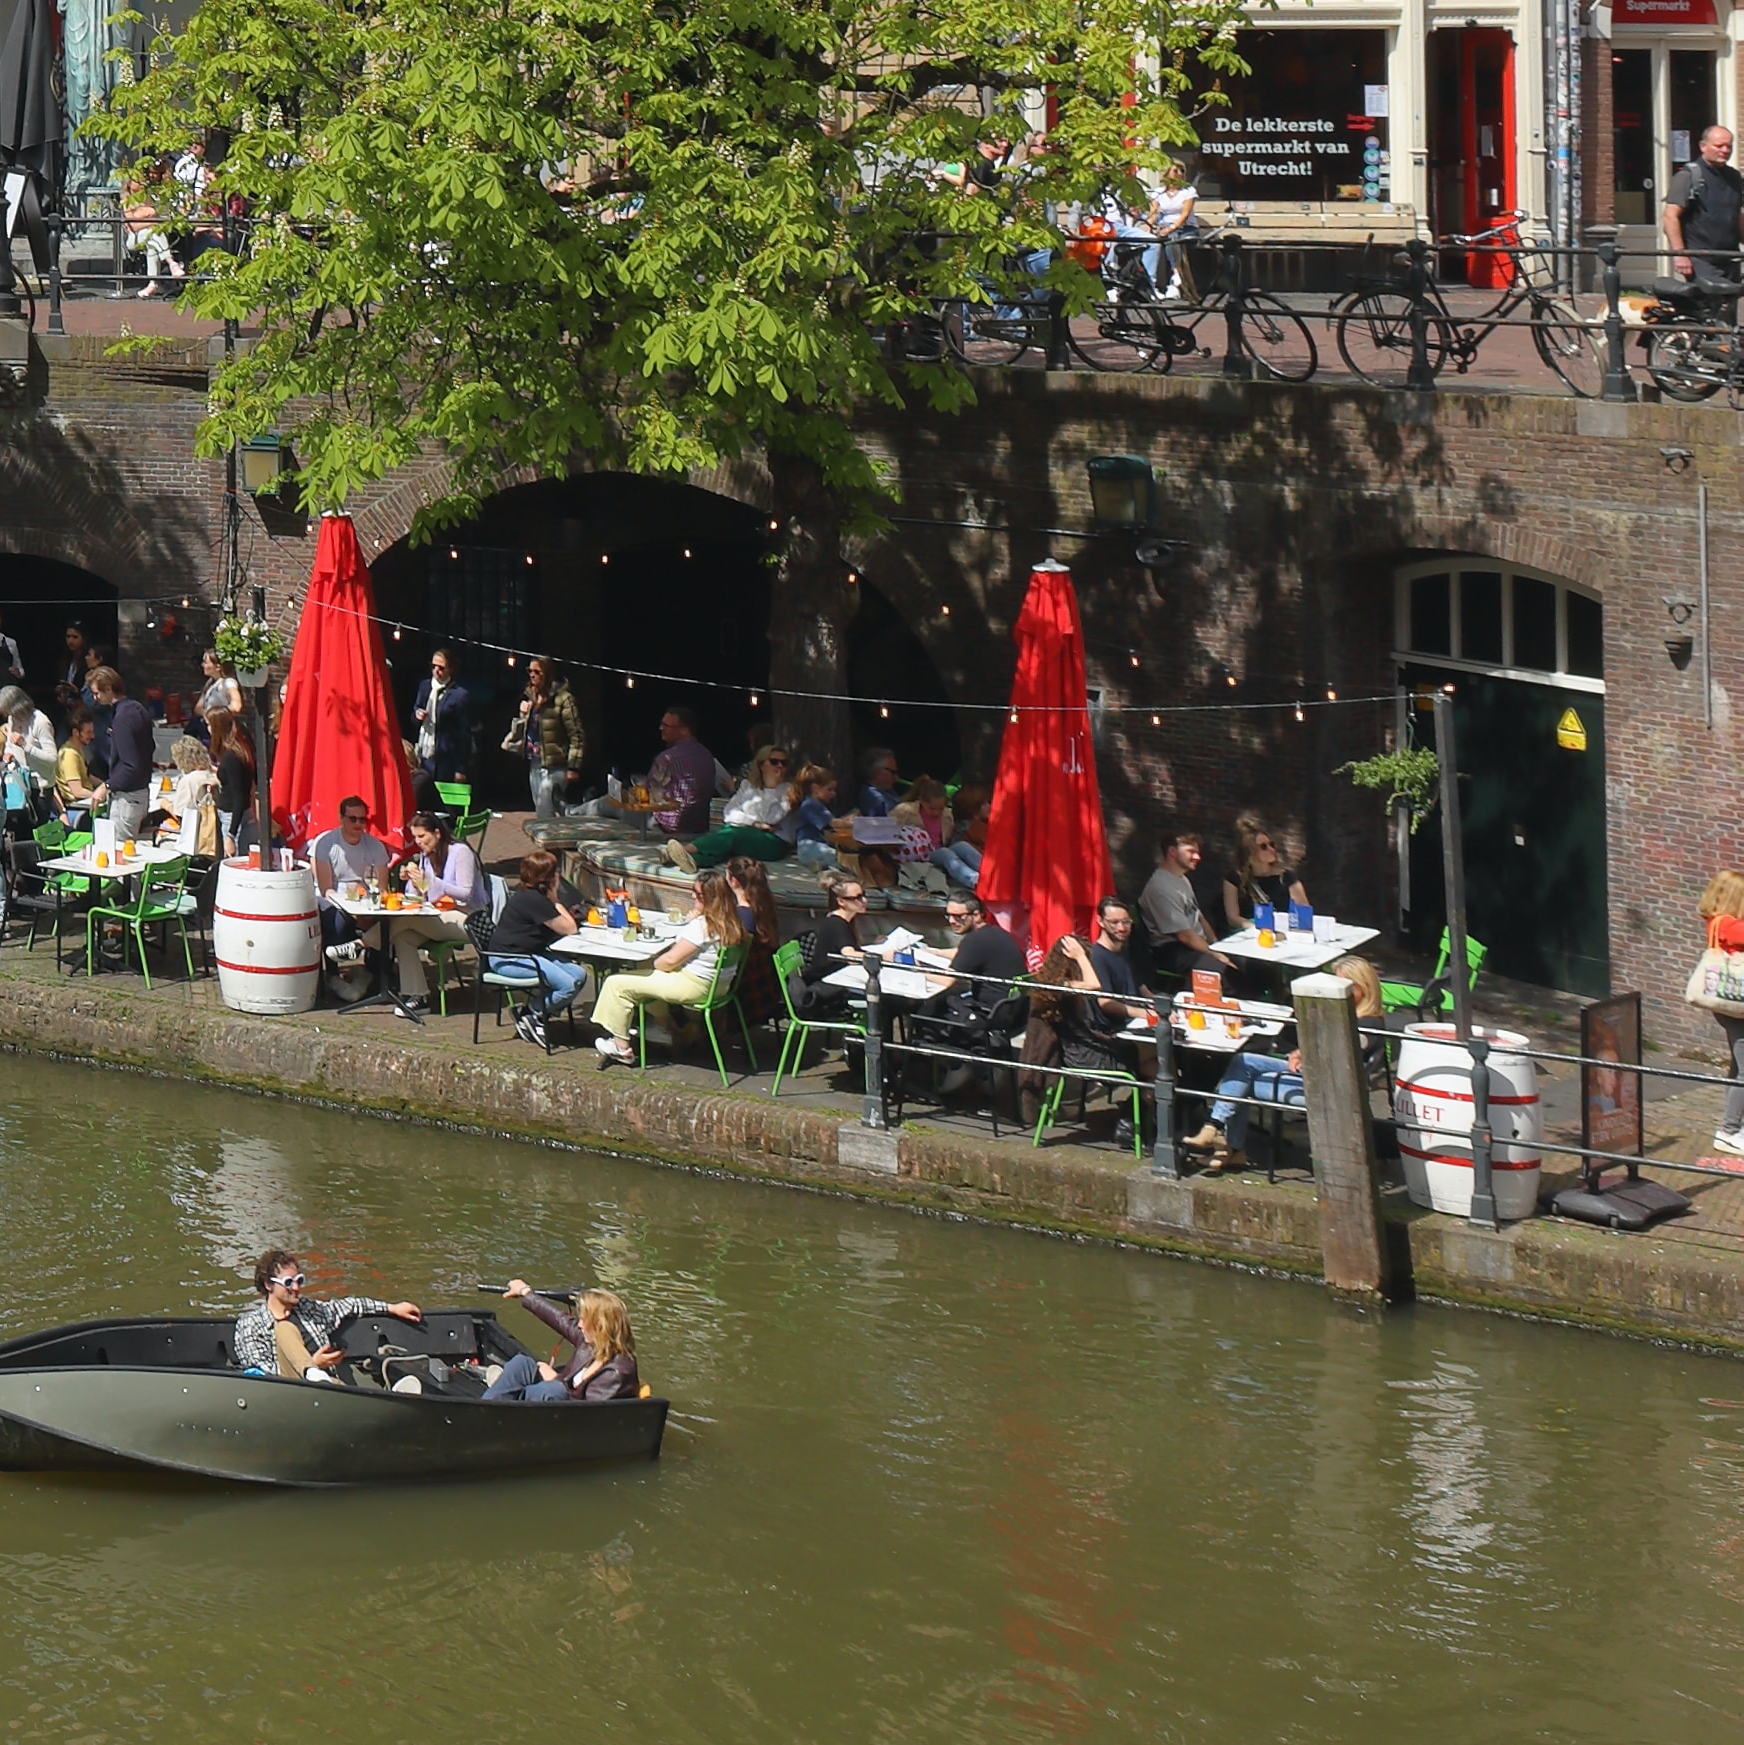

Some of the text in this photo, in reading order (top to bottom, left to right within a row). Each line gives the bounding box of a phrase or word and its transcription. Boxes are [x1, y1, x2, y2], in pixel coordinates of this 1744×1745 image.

[1626, 0, 1690, 13] Supermarkt
[1215, 117, 1242, 132] De
[1246, 117, 1334, 132] lekkerste
[1202, 139, 1349, 157] supermarkt van
[1238, 161, 1313, 176] Utrecht!
